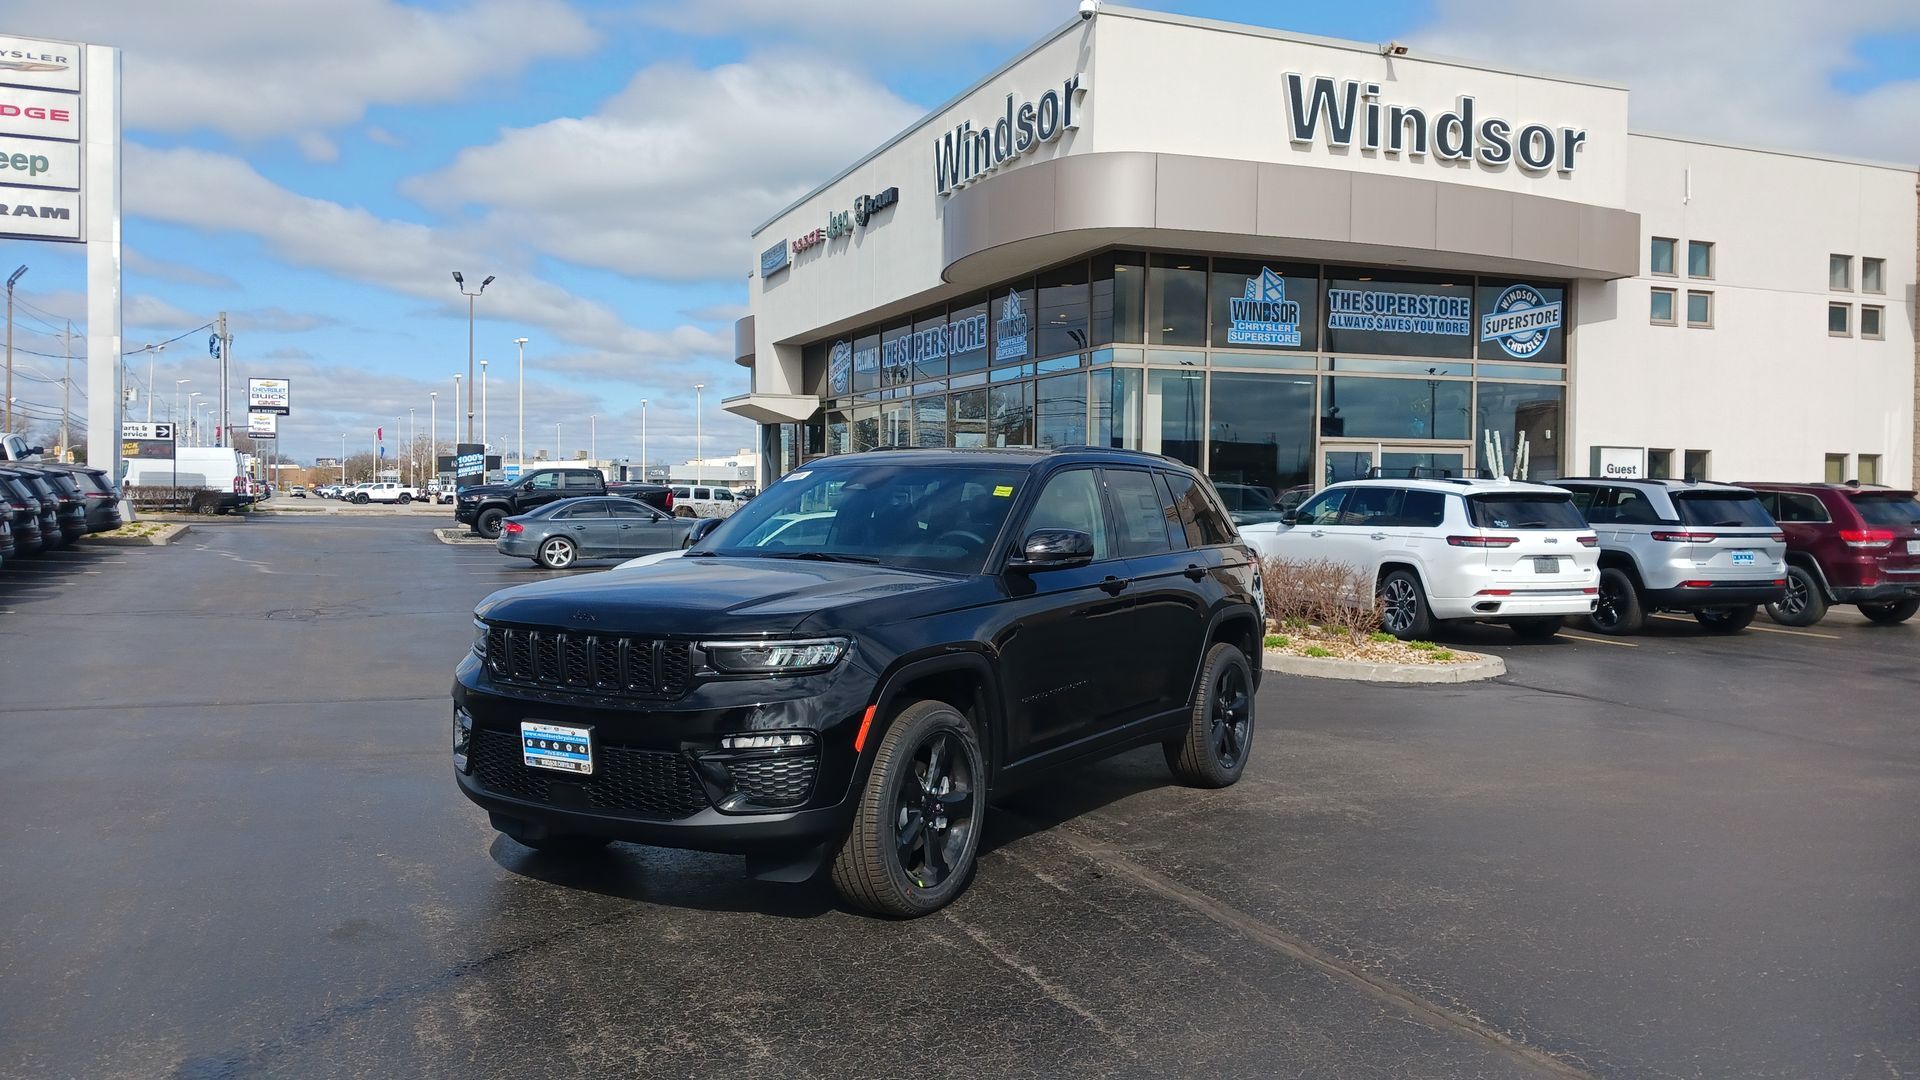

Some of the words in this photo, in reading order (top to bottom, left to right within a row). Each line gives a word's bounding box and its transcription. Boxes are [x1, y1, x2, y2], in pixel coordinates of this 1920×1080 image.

[1281, 71, 1588, 173] Windsor
[934, 73, 1087, 196] Windsor
[865, 187, 898, 216] RAM
[826, 210, 852, 240] Jeep
[1330, 291, 1361, 312] THE
[1364, 293, 1469, 317] SUPERSTORE
[1501, 290, 1538, 310] WINDSOR
[1232, 301, 1297, 323] WINDSOR
[1485, 308, 1558, 335] SUPERSTORE
[998, 316, 1026, 339] WINDSOR
[1238, 322, 1291, 332] CHRYSLER
[1330, 315, 1374, 329] ALWAYS
[1376, 317, 1411, 331] SAVES
[1413, 319, 1434, 332] YOU
[1436, 320, 1469, 333] MORE!
[882, 341, 897, 368] THE
[900, 314, 986, 366] SUPERSTORE
[1000, 336, 1024, 348] CHRYSLER
[1230, 331, 1298, 343] SUPERSTORE
[1506, 331, 1543, 353] CHRYSLER
[997, 344, 1027, 358] SUPERSTORE
[457, 465, 484, 474] AVAILABLE
[458, 453, 484, 464] 1000's
[1606, 463, 1637, 475] Guest
